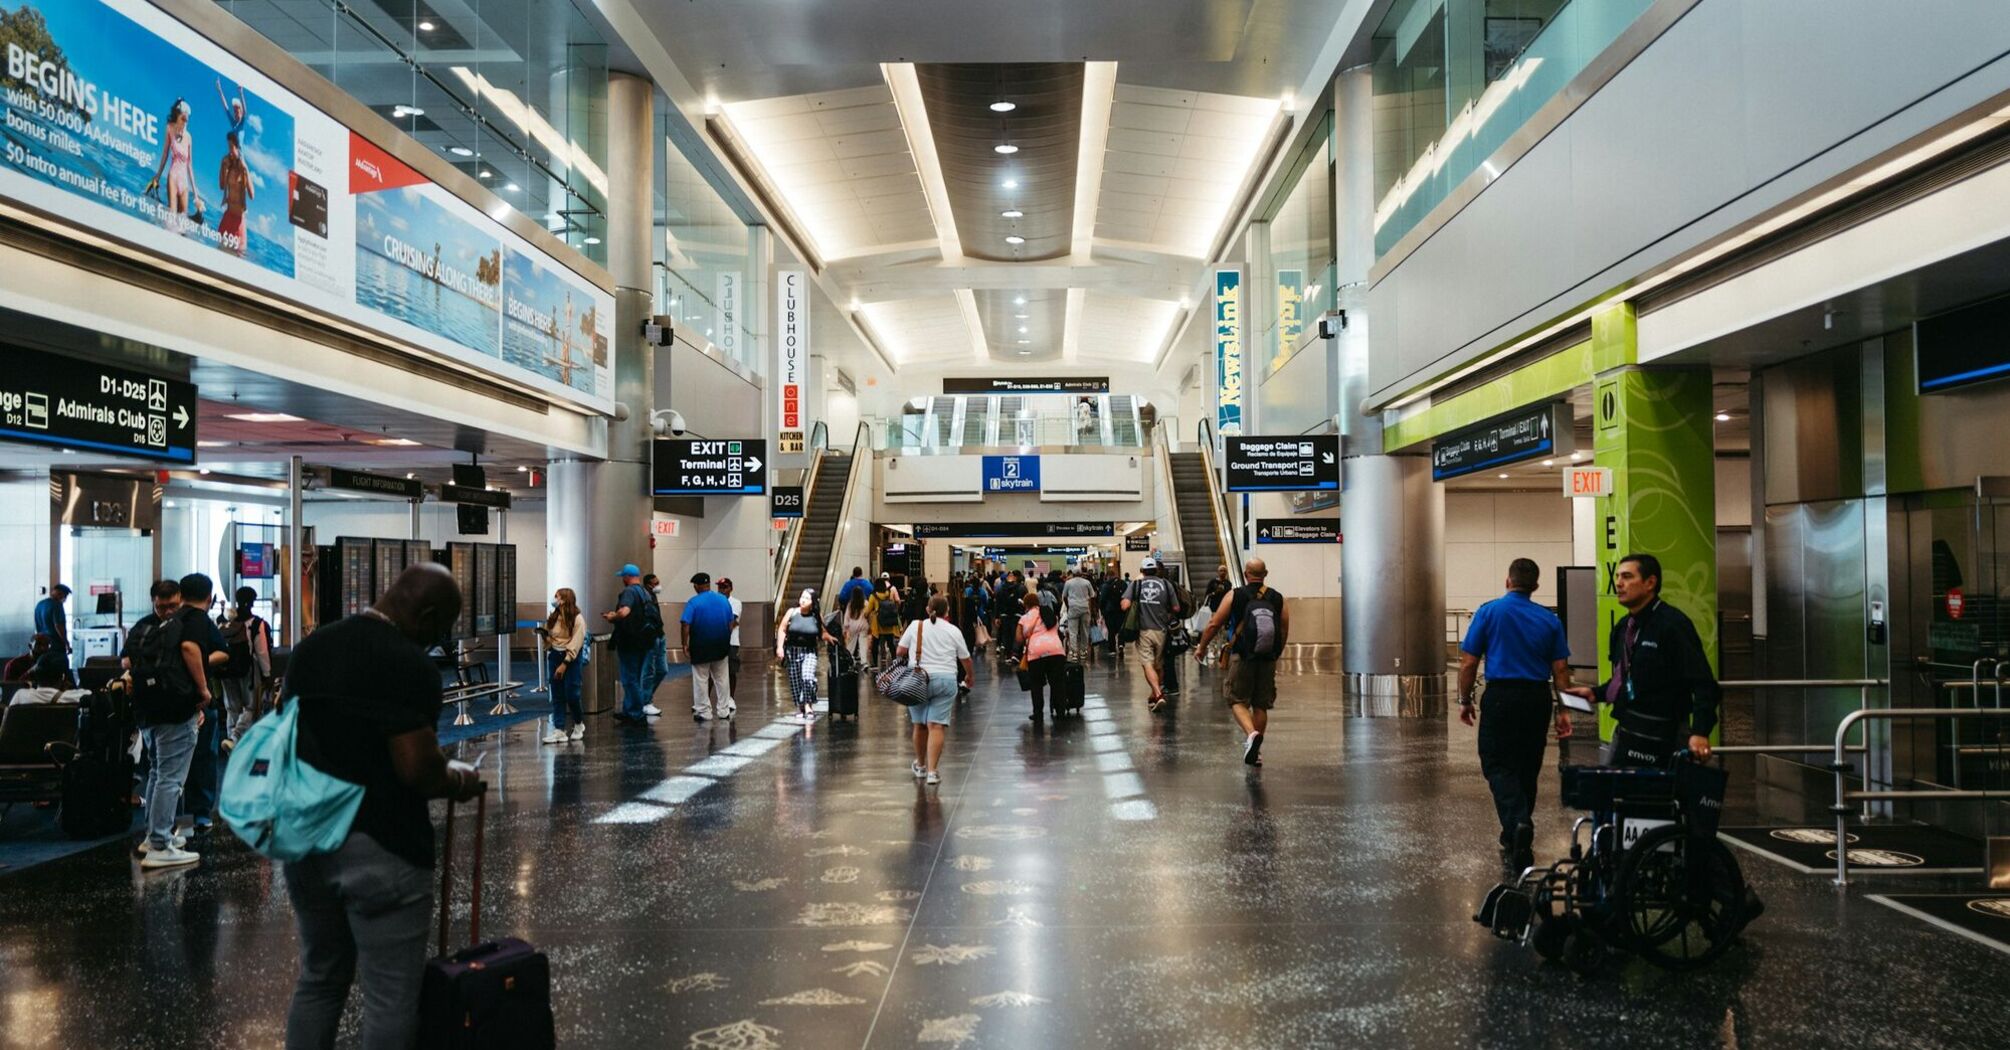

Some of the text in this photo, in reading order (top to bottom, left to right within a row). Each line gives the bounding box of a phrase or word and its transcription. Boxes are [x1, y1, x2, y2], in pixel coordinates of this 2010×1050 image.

[8, 42, 158, 146] BEGINS HERE
[6, 87, 37, 113] with
[39, 99, 82, 134] 50,000
[6, 107, 84, 157] bonus miles.
[6, 141, 24, 164] $0
[26, 148, 57, 177] intro
[59, 167, 99, 195] annual
[100, 179, 119, 199] fee
[120, 188, 137, 208] for
[138, 196, 155, 217] the
[157, 203, 177, 223] first
[200, 223, 222, 243] then
[384, 234, 434, 277] CRUISING
[434, 261, 467, 292] ALONG
[508, 296, 535, 325] BEGINS
[535, 312, 552, 334] HERE
[786, 274, 796, 383] CLUBHOUSE
[101, 375, 146, 401] D1-D25
[57, 397, 146, 430] Admirals Club
[785, 387, 797, 426] one
[6, 413, 22, 425] D12
[780, 431, 803, 440] KITCHEN
[691, 441, 726, 455] EXIT
[790, 442, 803, 451] BAR
[1240, 442, 1297, 451] Baggage Claim
[680, 459, 726, 469] Terminal
[1007, 463, 1017, 476] 2
[1261, 461, 1298, 471] Transport
[352, 475, 372, 487] FLIGHT
[681, 475, 726, 486] F, G, H, J
[1001, 478, 1033, 488] skytrain
[1573, 472, 1602, 493] EXIT
[775, 495, 800, 506] D25
[657, 521, 675, 534] EXIT
[1628, 749, 1656, 764] envoy
[1625, 826, 1638, 842] AA
